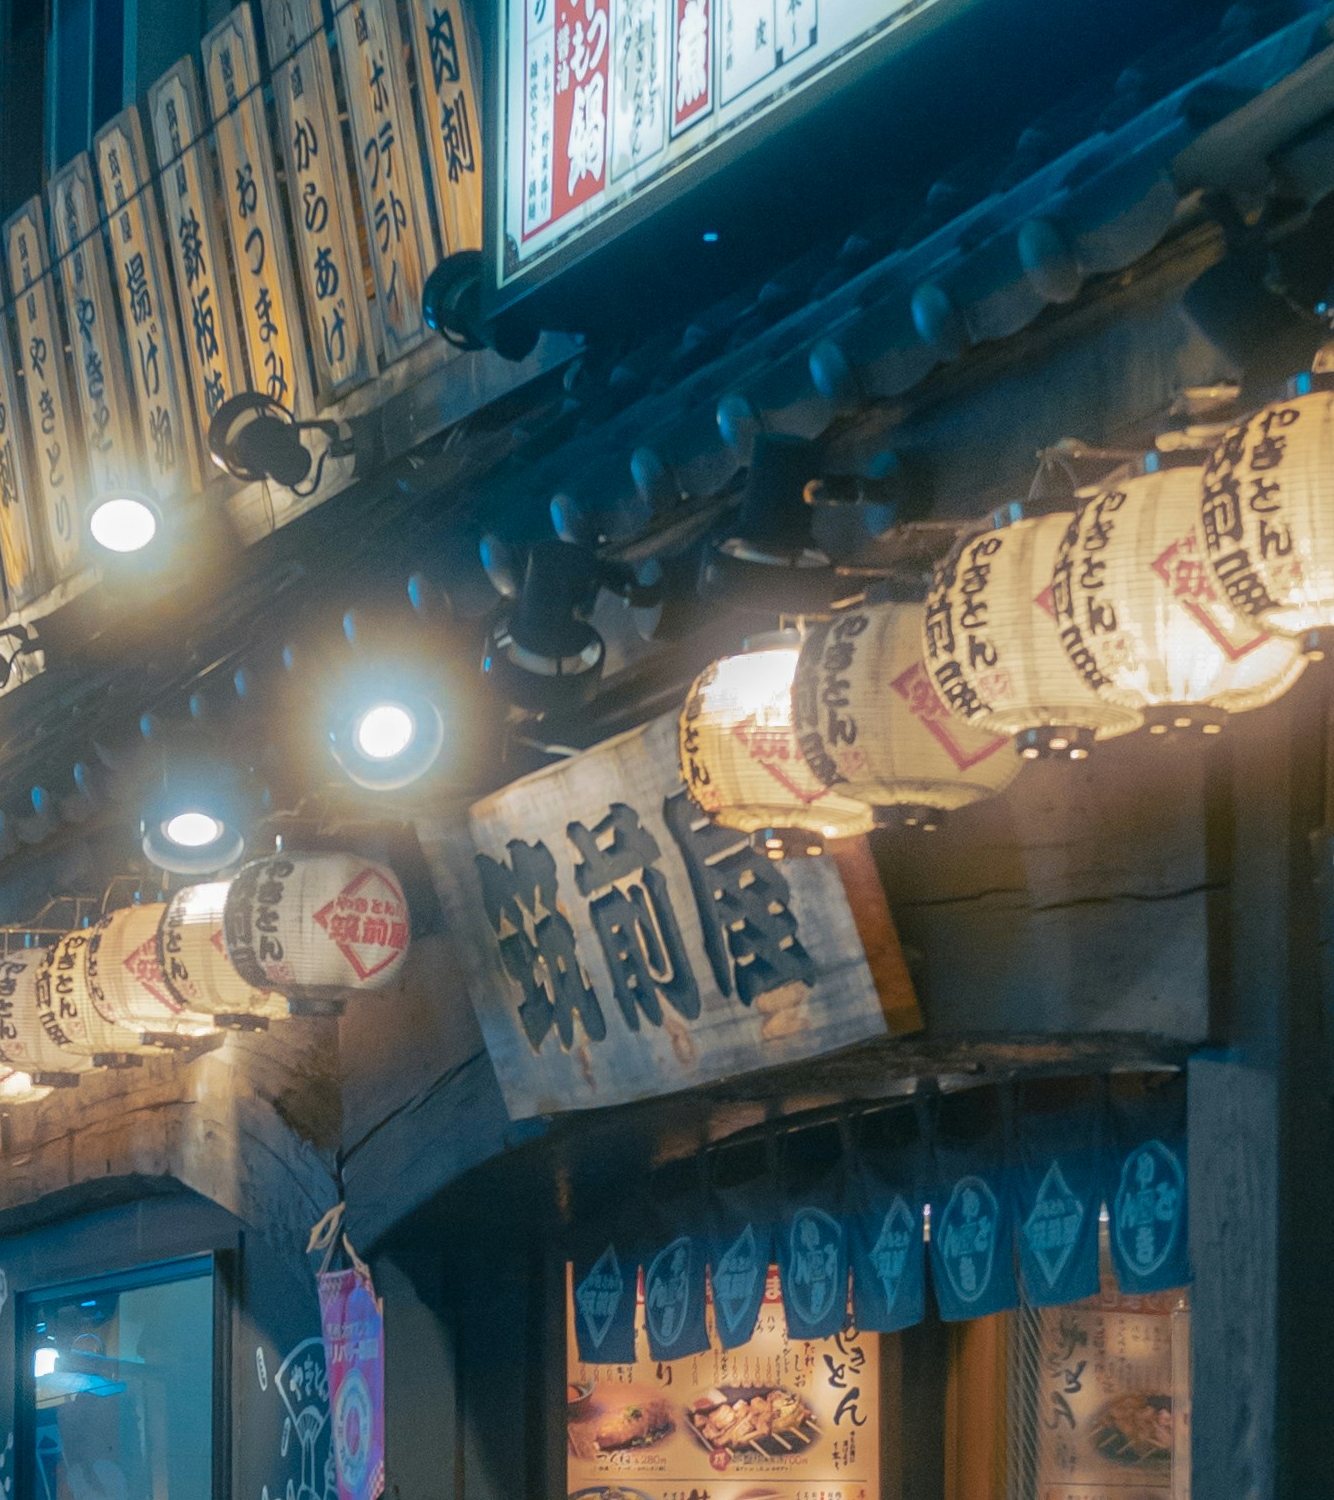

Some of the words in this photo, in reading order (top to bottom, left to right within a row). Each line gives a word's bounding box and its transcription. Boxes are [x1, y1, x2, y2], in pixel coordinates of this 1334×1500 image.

[369, 48, 407, 232] ポテト
[427, 8, 478, 185] 肉刺
[234, 163, 291, 400] おつまみ
[292, 117, 347, 368] からあげ
[364, 137, 405, 327] フライ
[30, 336, 73, 542] やきとり
[124, 252, 176, 476] 揚げ物
[1078, 490, 1127, 636] やきとん
[1249, 408, 1300, 558] やきとん
[819, 613, 869, 748] やきとん
[960, 537, 1004, 672] やきとん
[54, 934, 87, 1021] やきとん
[255, 859, 295, 963] やきとん
[329, 913, 408, 949] 筑前屋
[474, 798, 817, 1056] 筑前屋
